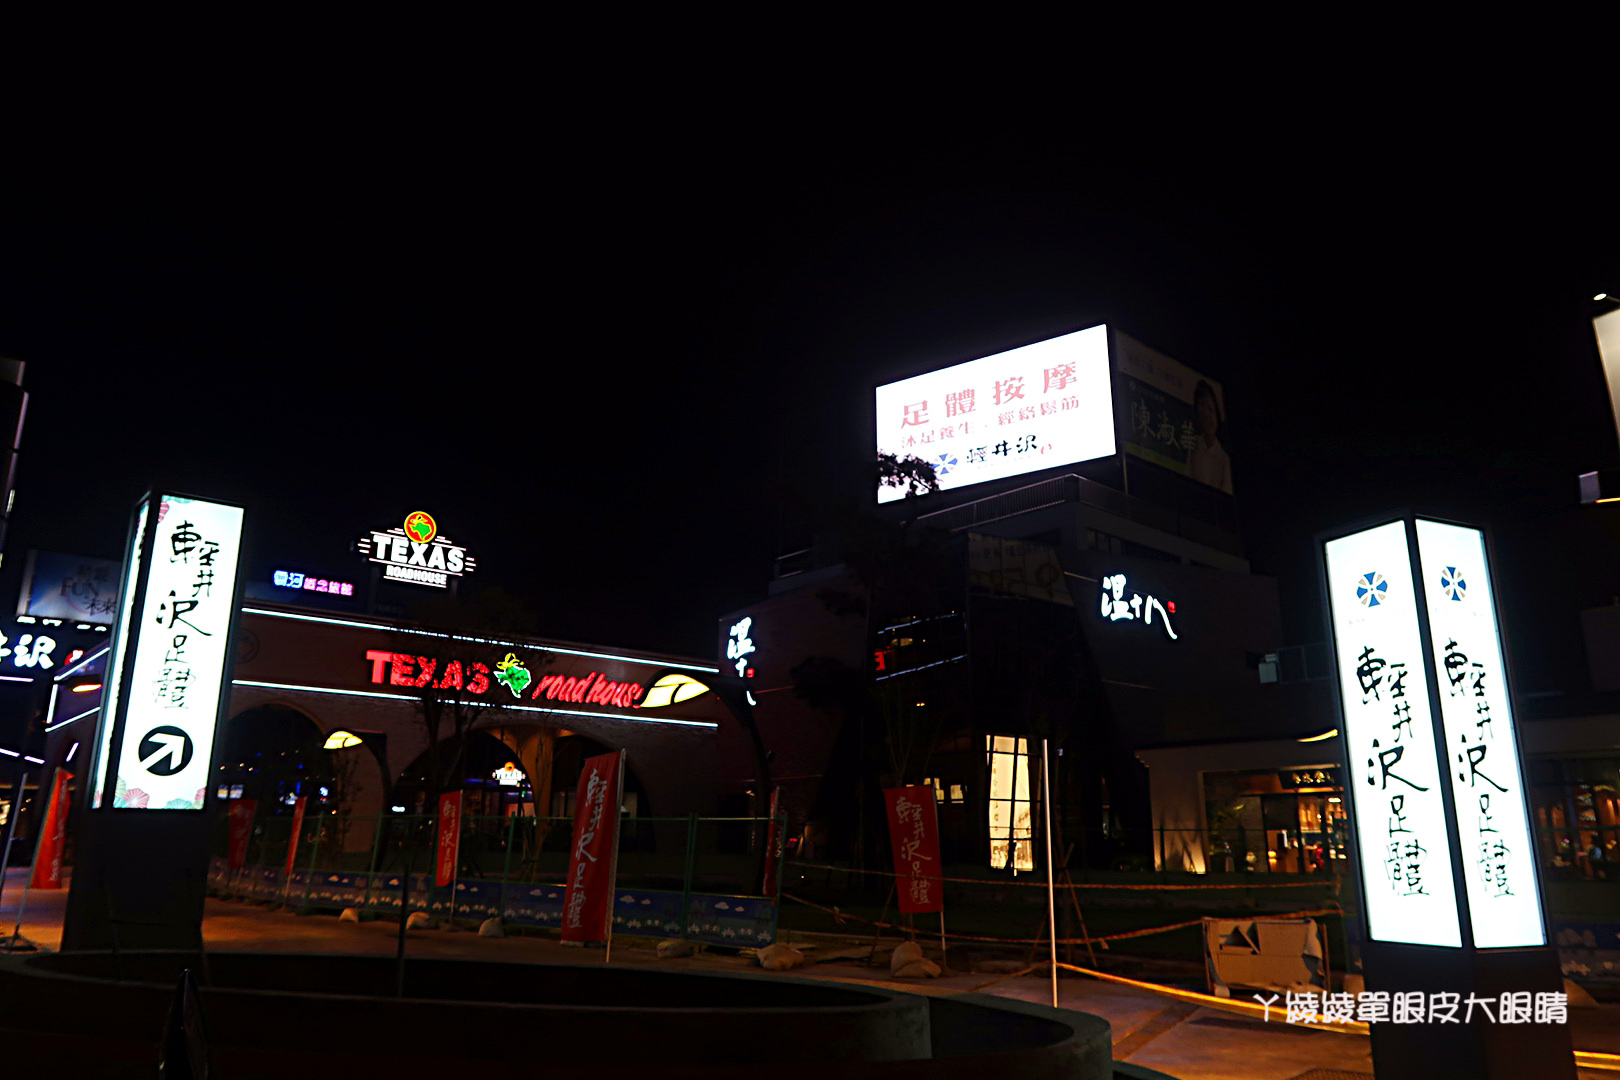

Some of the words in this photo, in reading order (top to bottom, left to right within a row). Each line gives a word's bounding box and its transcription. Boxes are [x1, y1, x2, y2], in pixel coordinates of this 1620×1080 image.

[901, 361, 1077, 430] 足體按摩
[373, 534, 464, 572] TEXAS
[386, 565, 447, 584] ROADHOUSE
[366, 649, 490, 694] TEXAS
